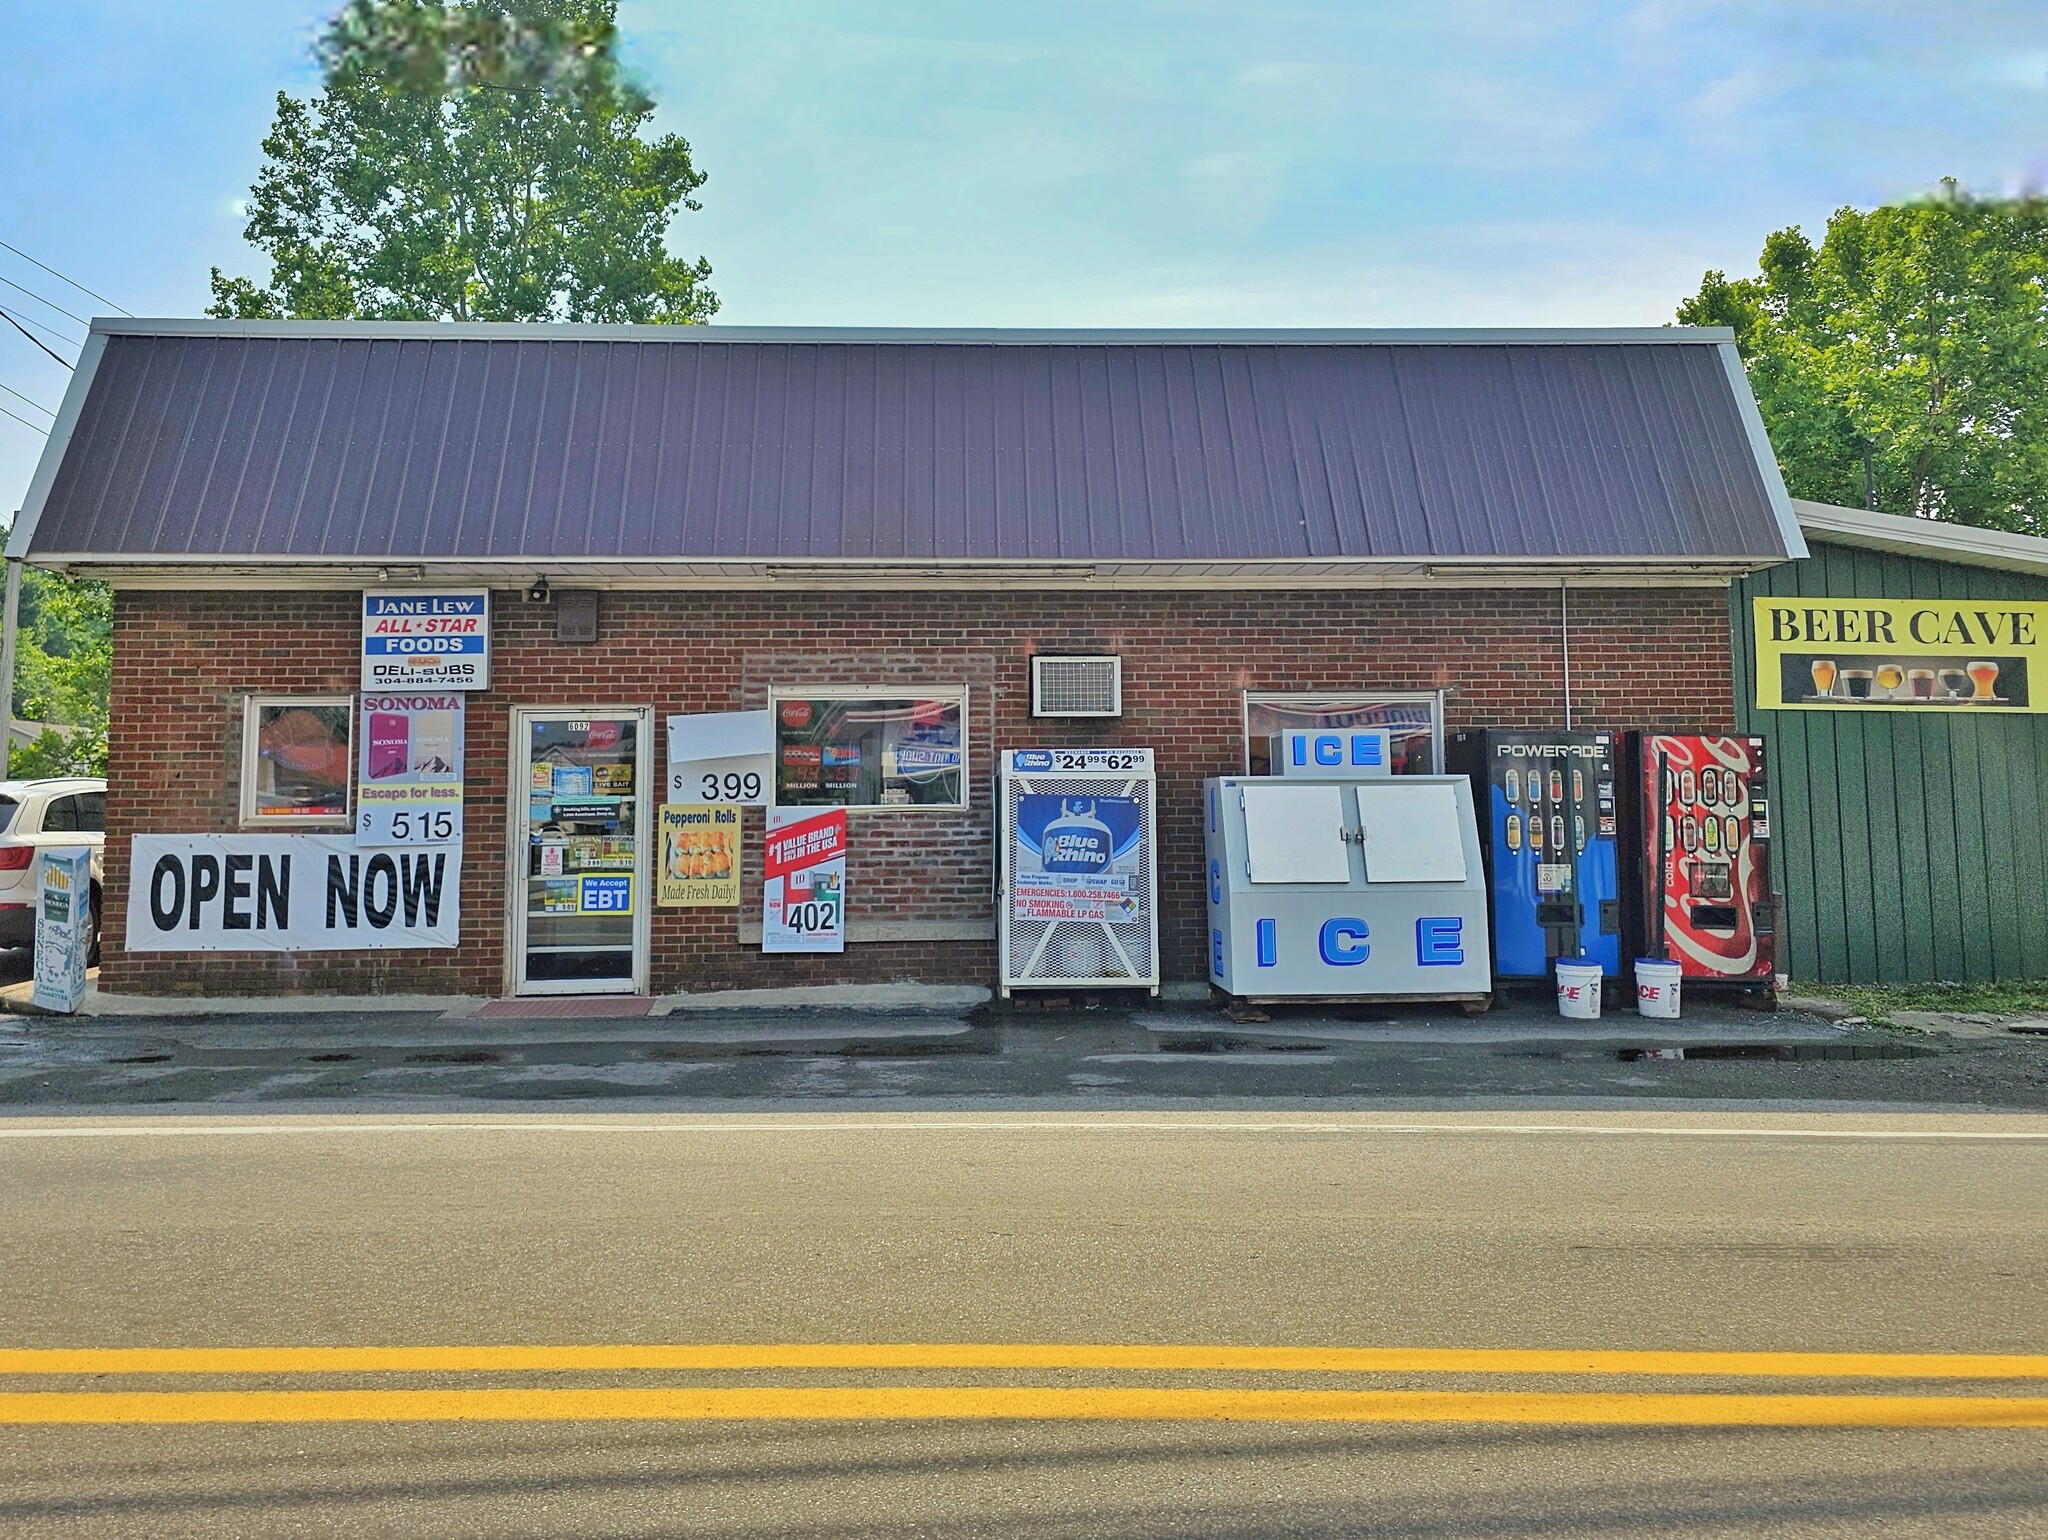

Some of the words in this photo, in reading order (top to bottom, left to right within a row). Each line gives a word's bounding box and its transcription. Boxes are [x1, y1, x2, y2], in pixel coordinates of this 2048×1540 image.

[376, 599, 427, 614] JANE
[432, 598, 475, 613] LEW
[374, 619, 412, 633] ALL
[424, 618, 477, 633] STAR
[1768, 608, 1897, 644] BEER
[1909, 610, 2037, 646] CAVE
[385, 637, 464, 653] FOODS
[373, 664, 475, 676] DELI-SUBS
[364, 696, 461, 711] SONOMA
[569, 722, 589, 731] 6092
[372, 738, 408, 746] SONOMA
[1292, 735, 1382, 766] ICE
[1497, 744, 1605, 758] POWERADE
[674, 775, 682, 790] $
[362, 787, 408, 801] Escape
[410, 787, 428, 798] for
[430, 786, 459, 798] less.
[362, 813, 372, 828] $
[391, 811, 453, 841] 5.15
[664, 809, 710, 828] Pepperoni
[715, 809, 736, 824] Rolls
[783, 835, 807, 851] VALUE
[808, 825, 834, 844] BRAND
[1058, 834, 1099, 849] Blue
[768, 842, 782, 864] #1
[797, 846, 806, 858] IN
[806, 840, 821, 855] THE
[822, 836, 838, 850] USA
[1052, 848, 1106, 864] Rhino
[150, 853, 291, 931] OPEN
[325, 852, 446, 929] NOW
[599, 879, 628, 888] Accept
[584, 890, 627, 909] EBT
[661, 885, 685, 900] Made
[686, 884, 710, 900] Fresh
[711, 884, 736, 904] Daily!
[1016, 899, 1027, 908] NO
[1028, 899, 1065, 909] SMOKING
[788, 902, 834, 933] 402
[1027, 908, 1075, 918] FLAMMABLE
[1077, 910, 1087, 918] LP
[1088, 910, 1104, 919] GAS
[1256, 917, 1465, 968] ICE
